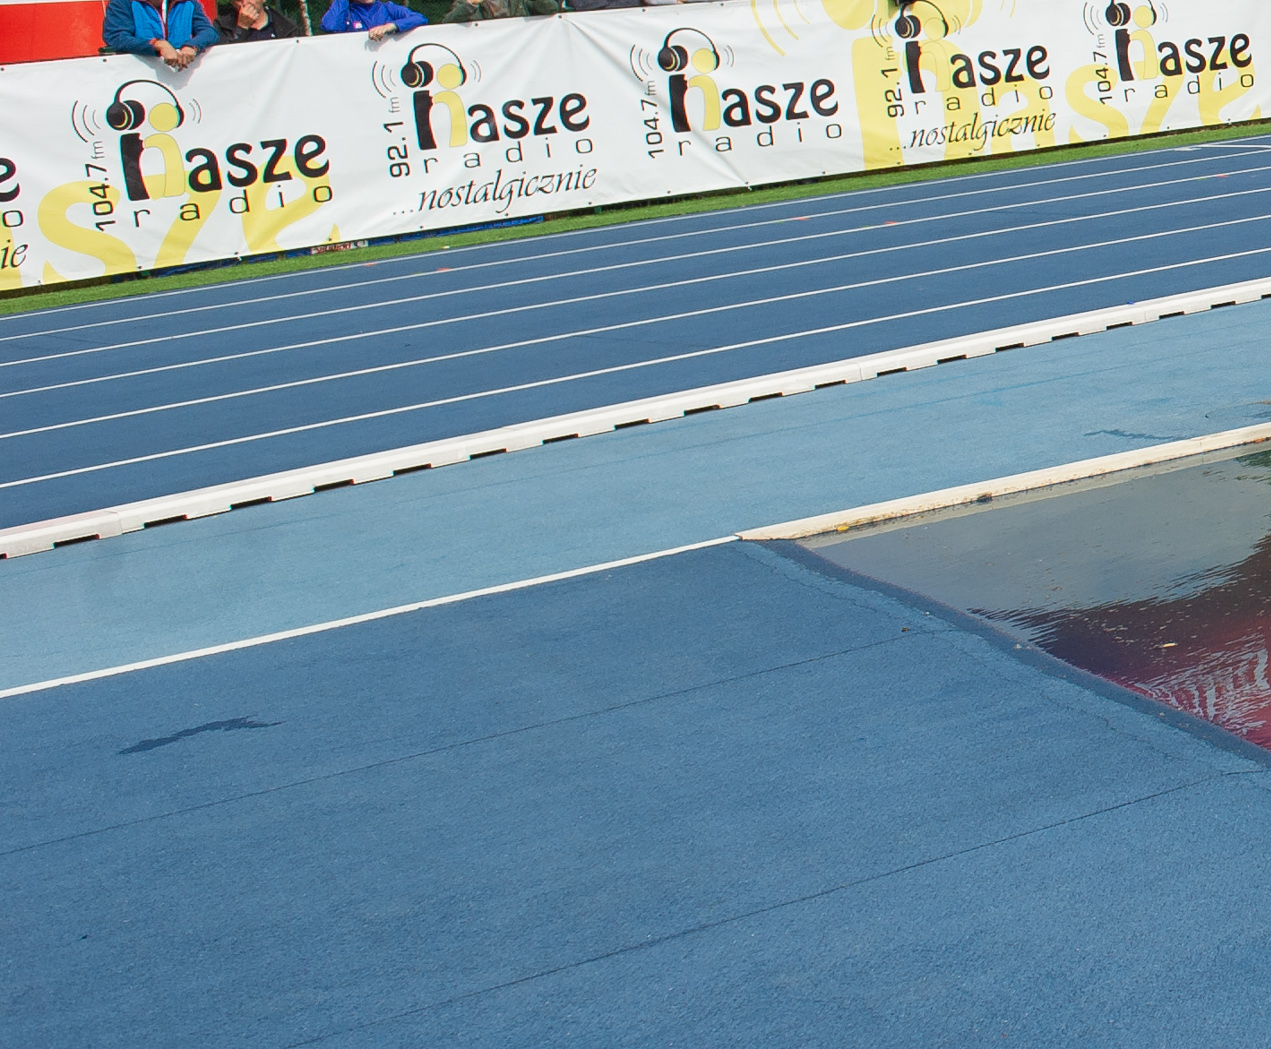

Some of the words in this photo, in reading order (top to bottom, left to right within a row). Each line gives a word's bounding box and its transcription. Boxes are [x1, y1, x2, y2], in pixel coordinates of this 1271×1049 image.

[880, 67, 905, 118] 92.1
[914, 84, 1054, 115] radio
[1092, 50, 1113, 105] 104.7
[1123, 71, 1255, 103] radio
[383, 121, 411, 179] 92.1
[640, 98, 665, 159] 104.7
[678, 121, 843, 157] radio
[423, 136, 594, 174] radio
[84, 162, 117, 232] 104.7
[133, 184, 334, 228] radio
